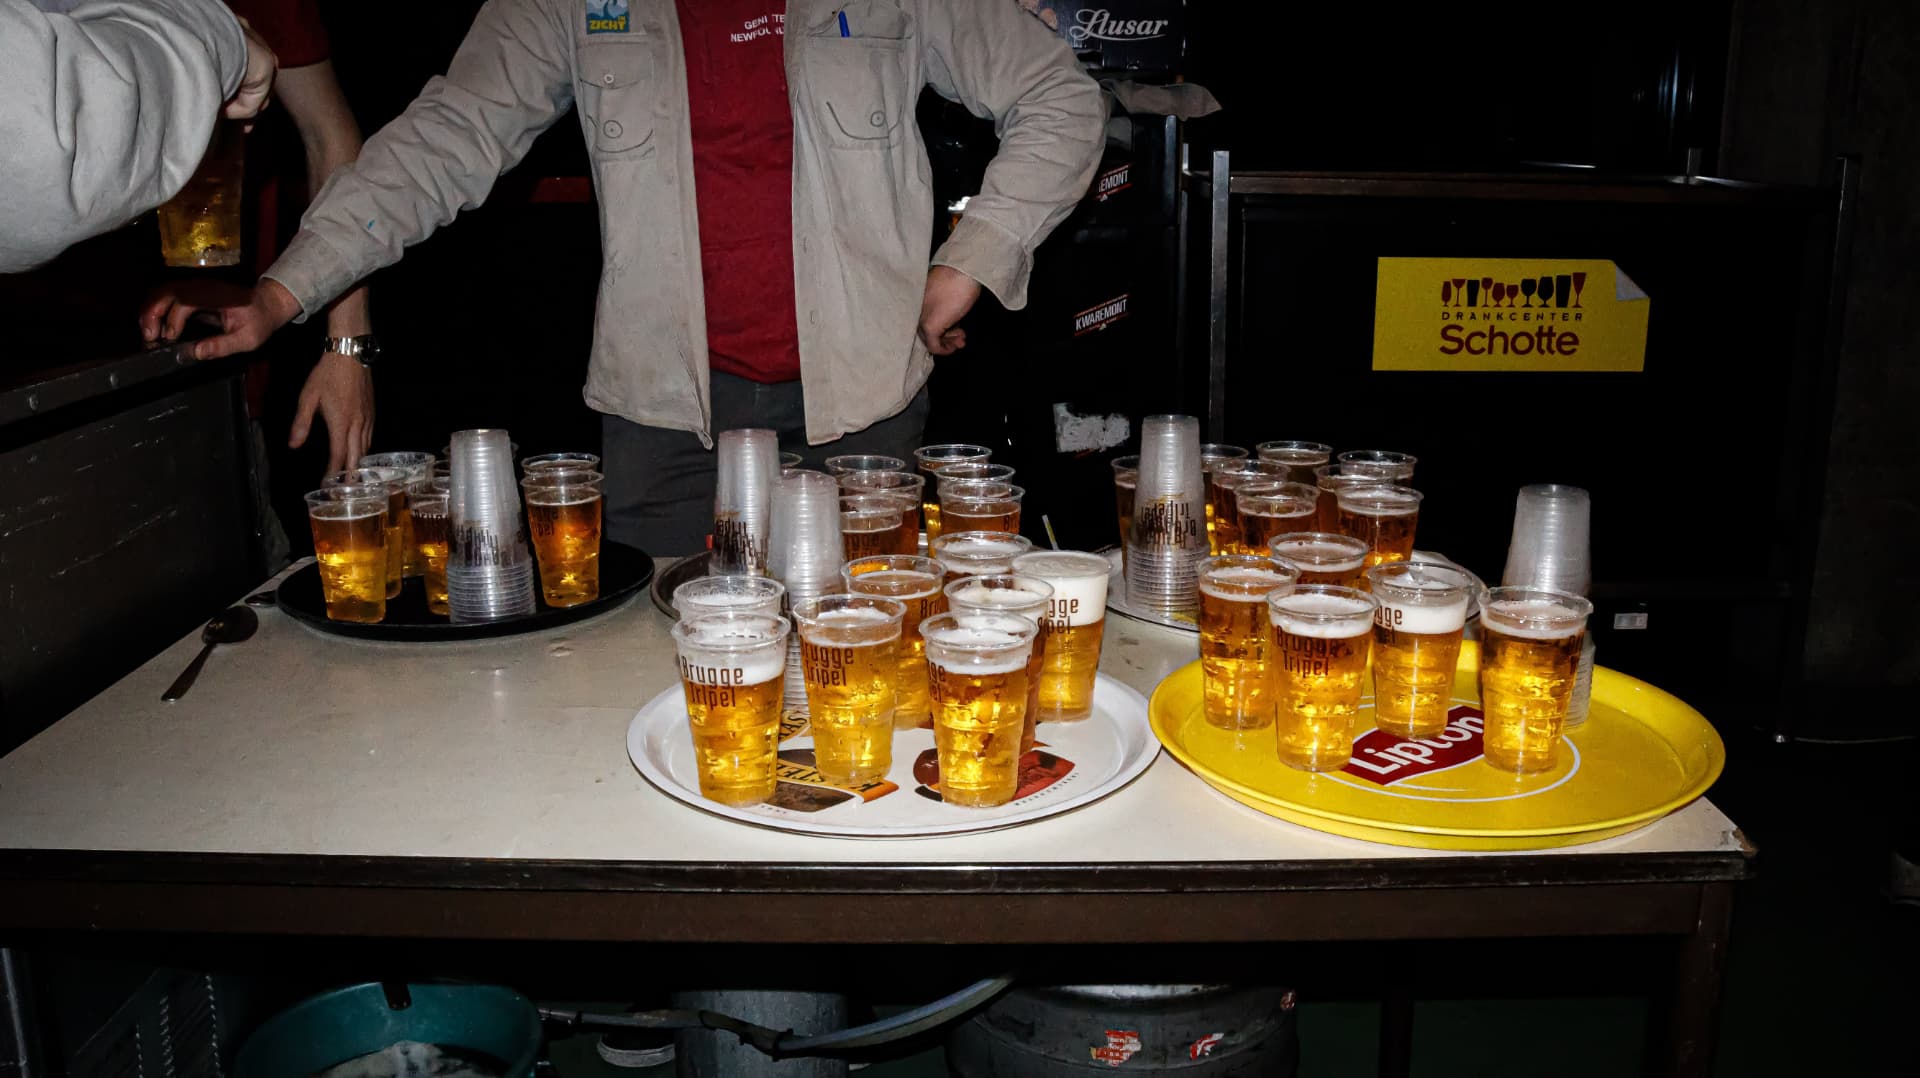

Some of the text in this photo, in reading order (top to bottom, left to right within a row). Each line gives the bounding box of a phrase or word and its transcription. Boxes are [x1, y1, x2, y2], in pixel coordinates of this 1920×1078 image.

[589, 19, 626, 31] ZICHT
[1098, 169, 1129, 192] EMONT
[1075, 297, 1128, 331] KWAREMONT
[1441, 311, 1583, 321] DRANKCENTER
[1439, 324, 1580, 356] Schotte
[681, 655, 744, 690] Brugge
[1282, 649, 1329, 678] Tripel
[688, 682, 736, 711] Tripel
[1350, 715, 1485, 775] Lipton
